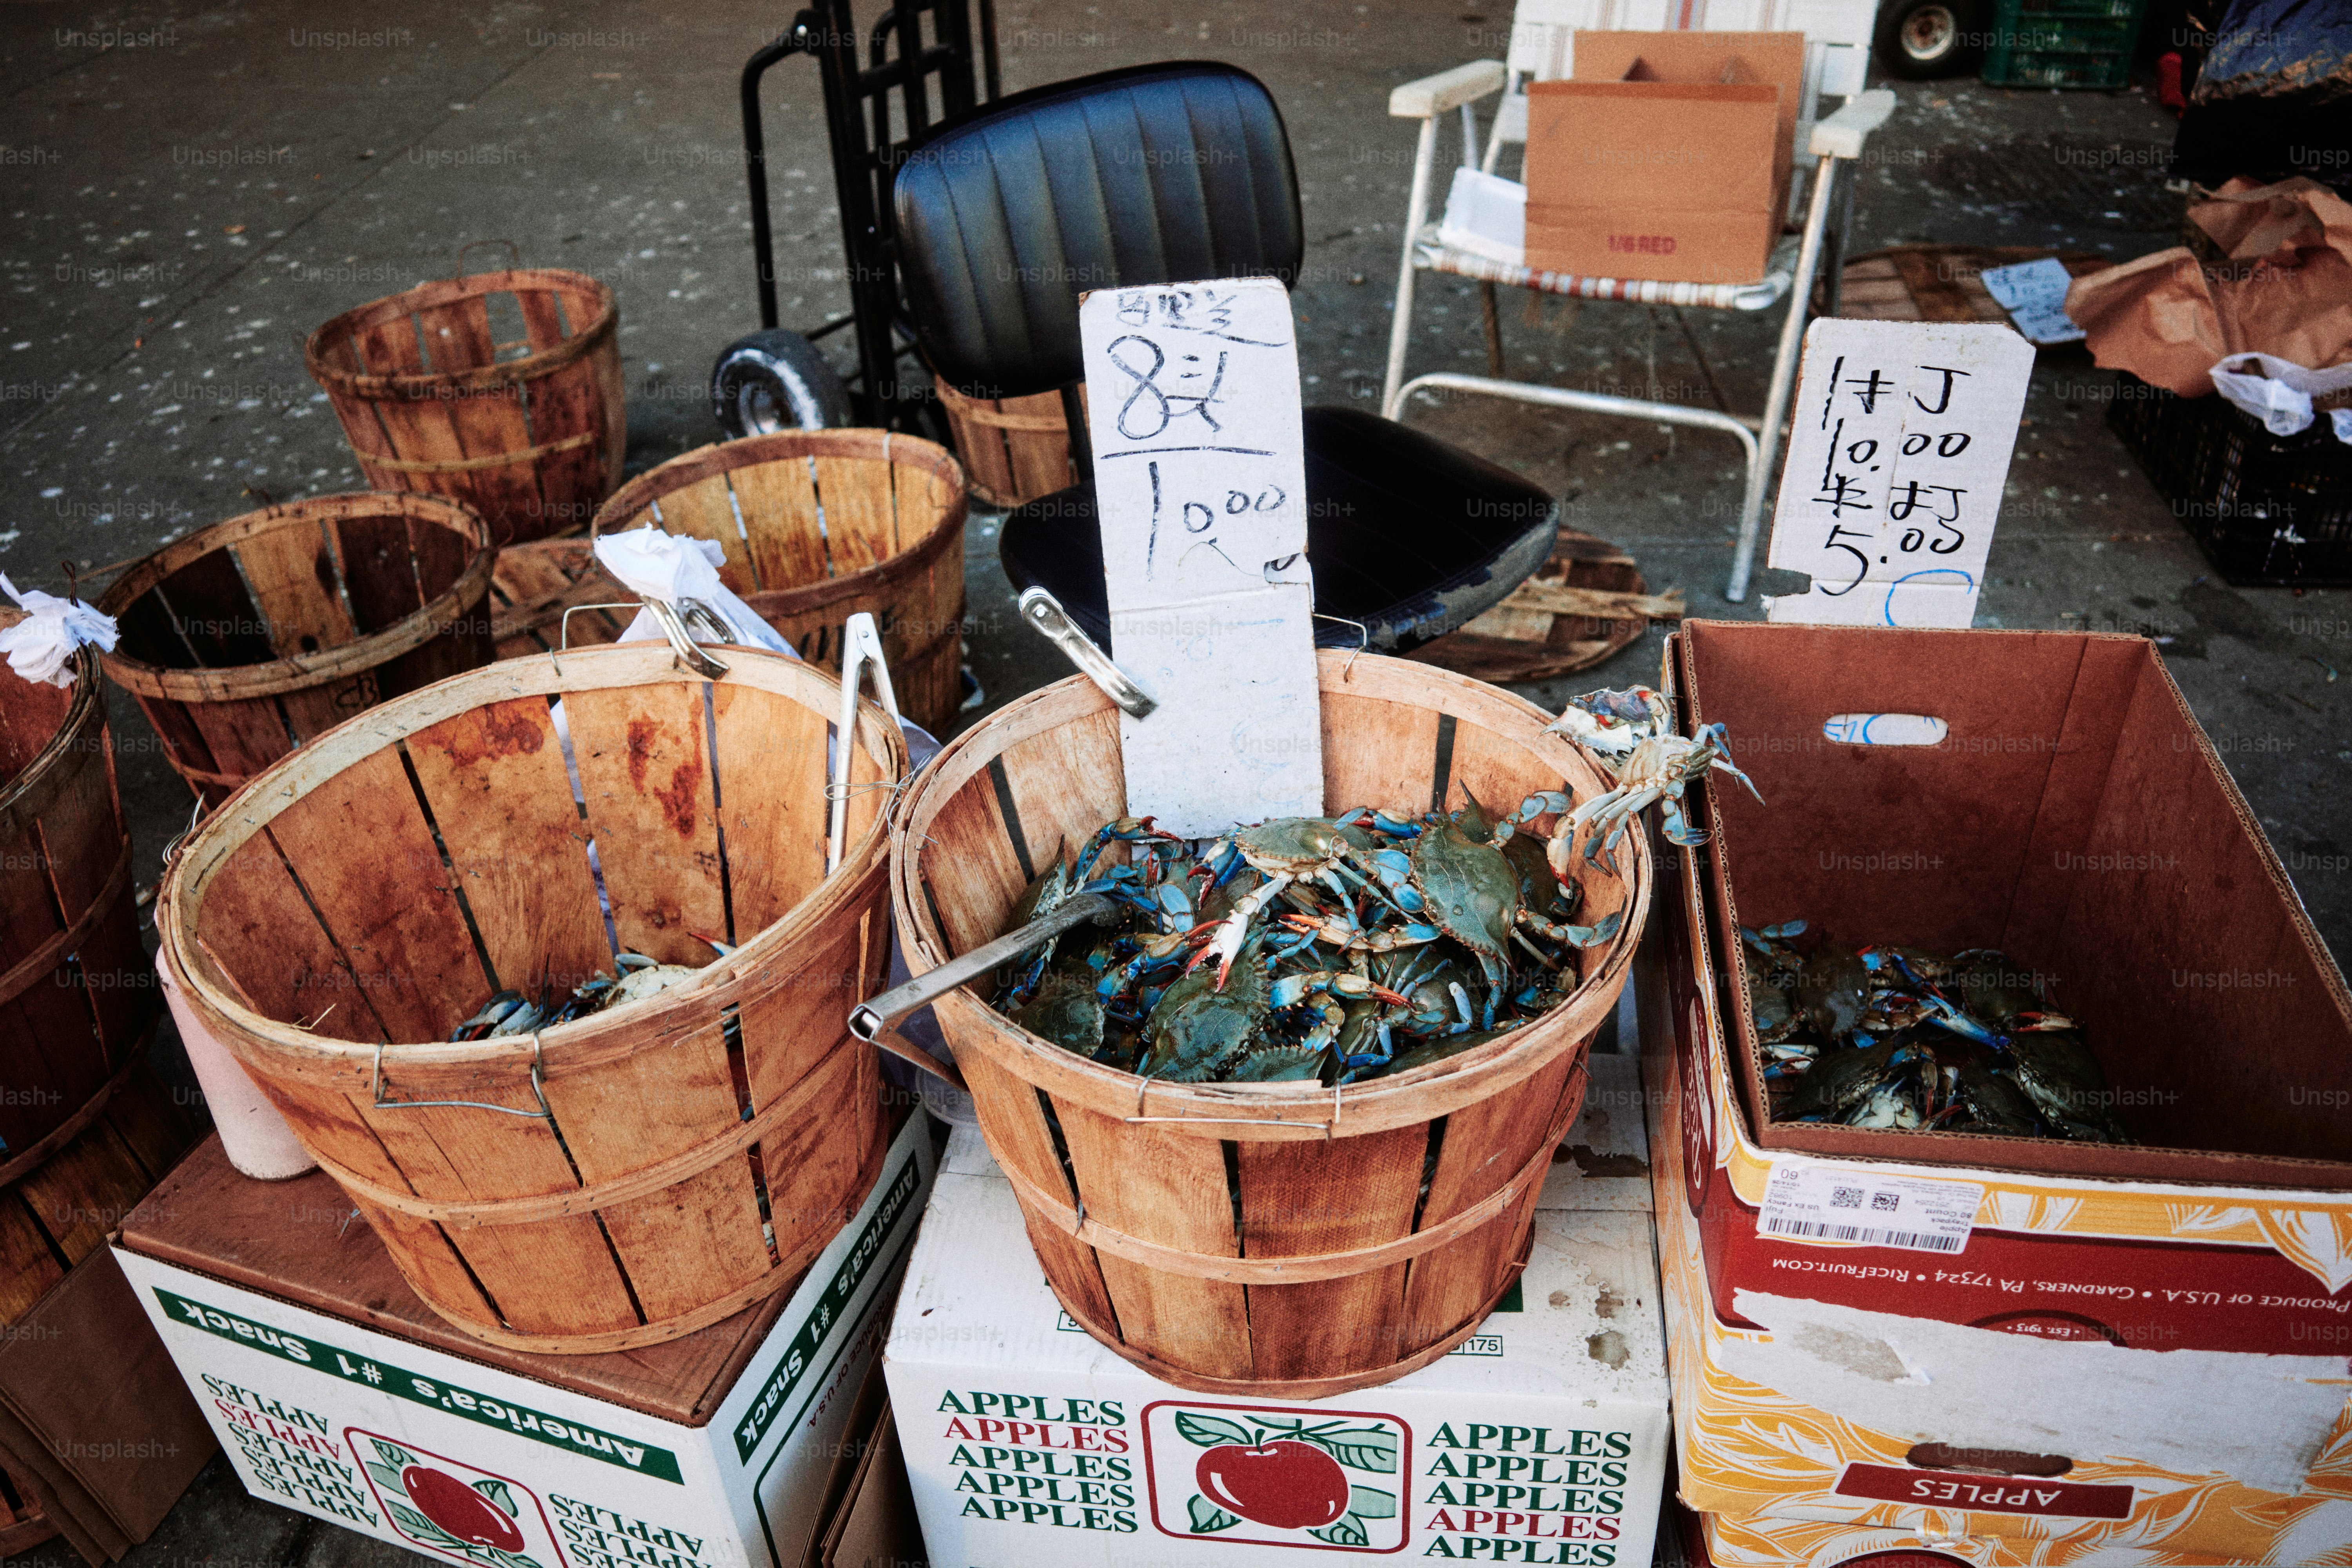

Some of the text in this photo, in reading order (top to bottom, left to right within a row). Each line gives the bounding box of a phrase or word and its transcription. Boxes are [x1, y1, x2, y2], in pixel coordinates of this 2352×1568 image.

[1638, 235, 1678, 255] RED
[1693, 1029, 1705, 1105] APPLES
[1780, 1169, 1798, 1180] 60
[1767, 1199, 1792, 1207] Fancy
[1925, 1208, 1957, 1218] Count
[1939, 1225, 1968, 1234] Apple
[1935, 1269, 1993, 1287] 17324
[1999, 1278, 2025, 1293] PA
[741, 1163, 914, 1446] America's #1 Snack
[1468, 1339, 1498, 1352] 175
[2016, 1322, 2043, 1333] 1913
[177, 1300, 647, 1465] America's #1 Snack
[835, 1363, 849, 1388] OF
[201, 1372, 330, 1436] APPLES
[936, 1389, 1125, 1426] APPLES
[214, 1398, 341, 1461] APPLES
[943, 1416, 1130, 1454] APPLES
[1426, 1421, 1632, 1459] APPLES
[227, 1422, 355, 1484] APPLES
[948, 1444, 1132, 1481] APPLES
[1425, 1452, 1628, 1487] APPLES
[240, 1445, 367, 1507] APPLES
[954, 1470, 1135, 1508] APPLES
[1911, 1477, 2063, 1508] APPLES
[254, 1468, 379, 1528] APPLES
[960, 1496, 1138, 1533] APPLES
[1424, 1481, 1624, 1515] APPLES
[548, 1493, 704, 1557] APPLES
[1424, 1508, 1621, 1540] APPLES
[1423, 1535, 1616, 1567] APPLES
